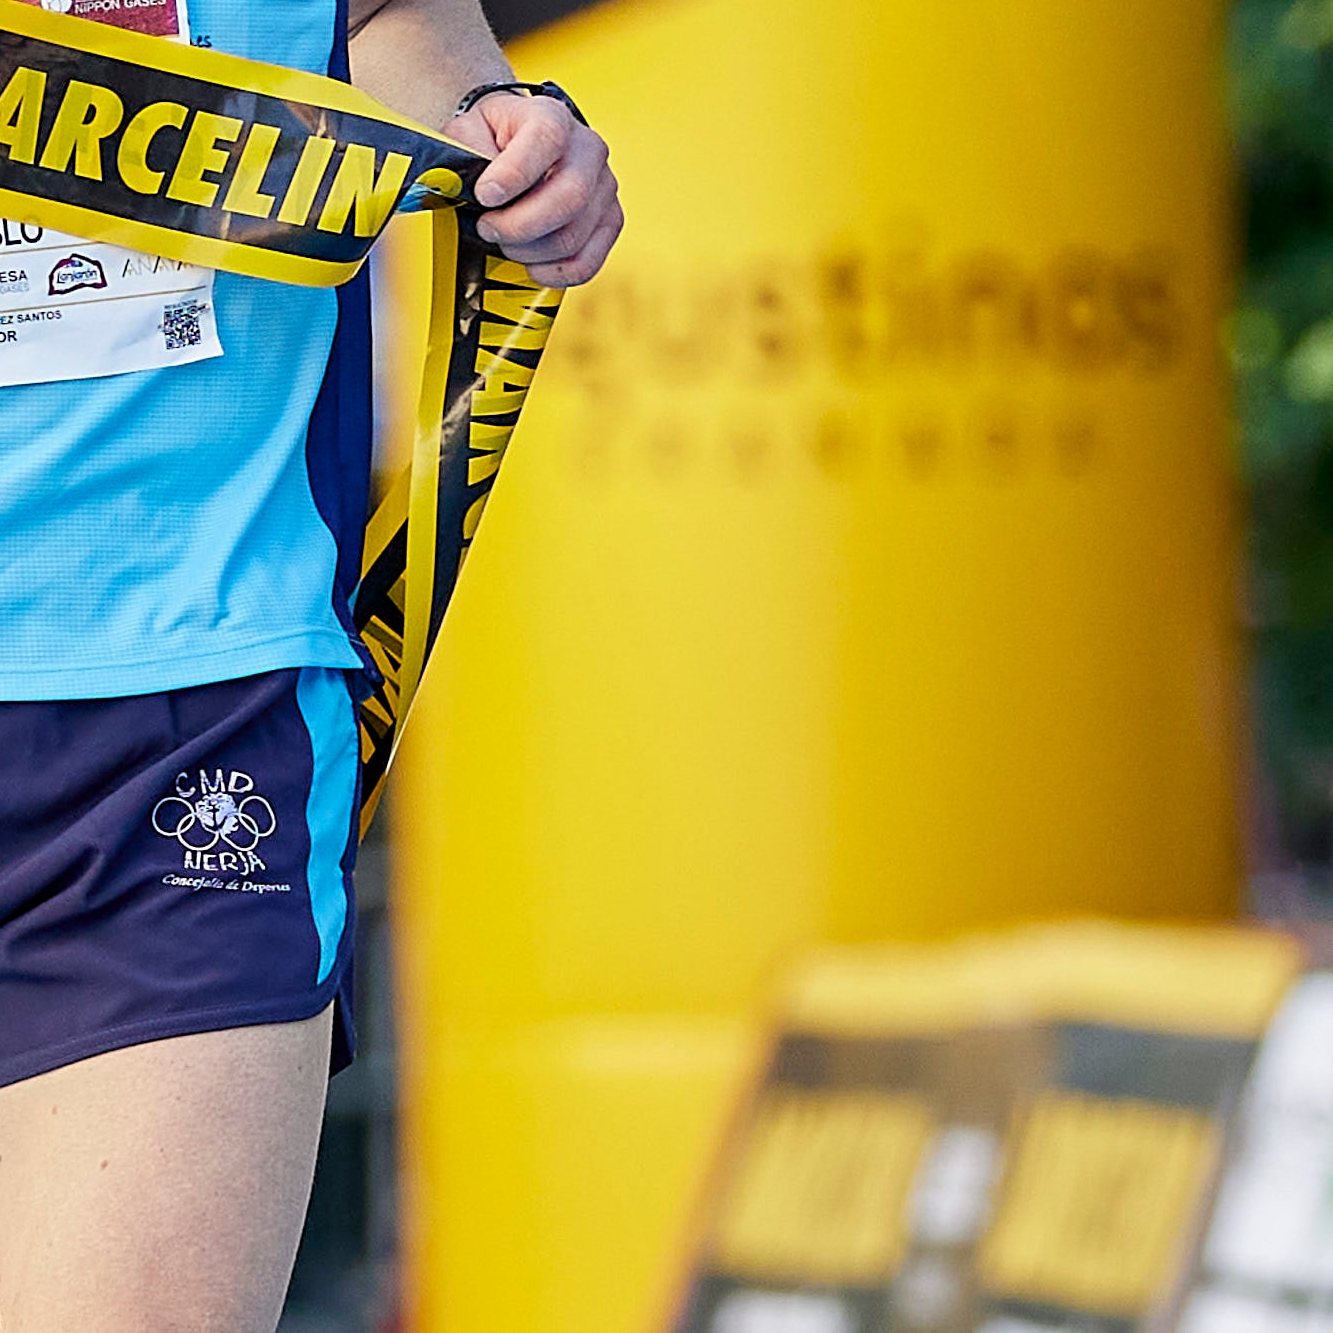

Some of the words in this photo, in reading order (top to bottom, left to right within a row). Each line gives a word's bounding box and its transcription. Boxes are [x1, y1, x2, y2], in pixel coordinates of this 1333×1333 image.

[74, 0, 121, 15] NIPPON
[17, 310, 63, 324] SANTOS
[175, 768, 255, 798] CMD
[183, 850, 267, 876] NERJA
